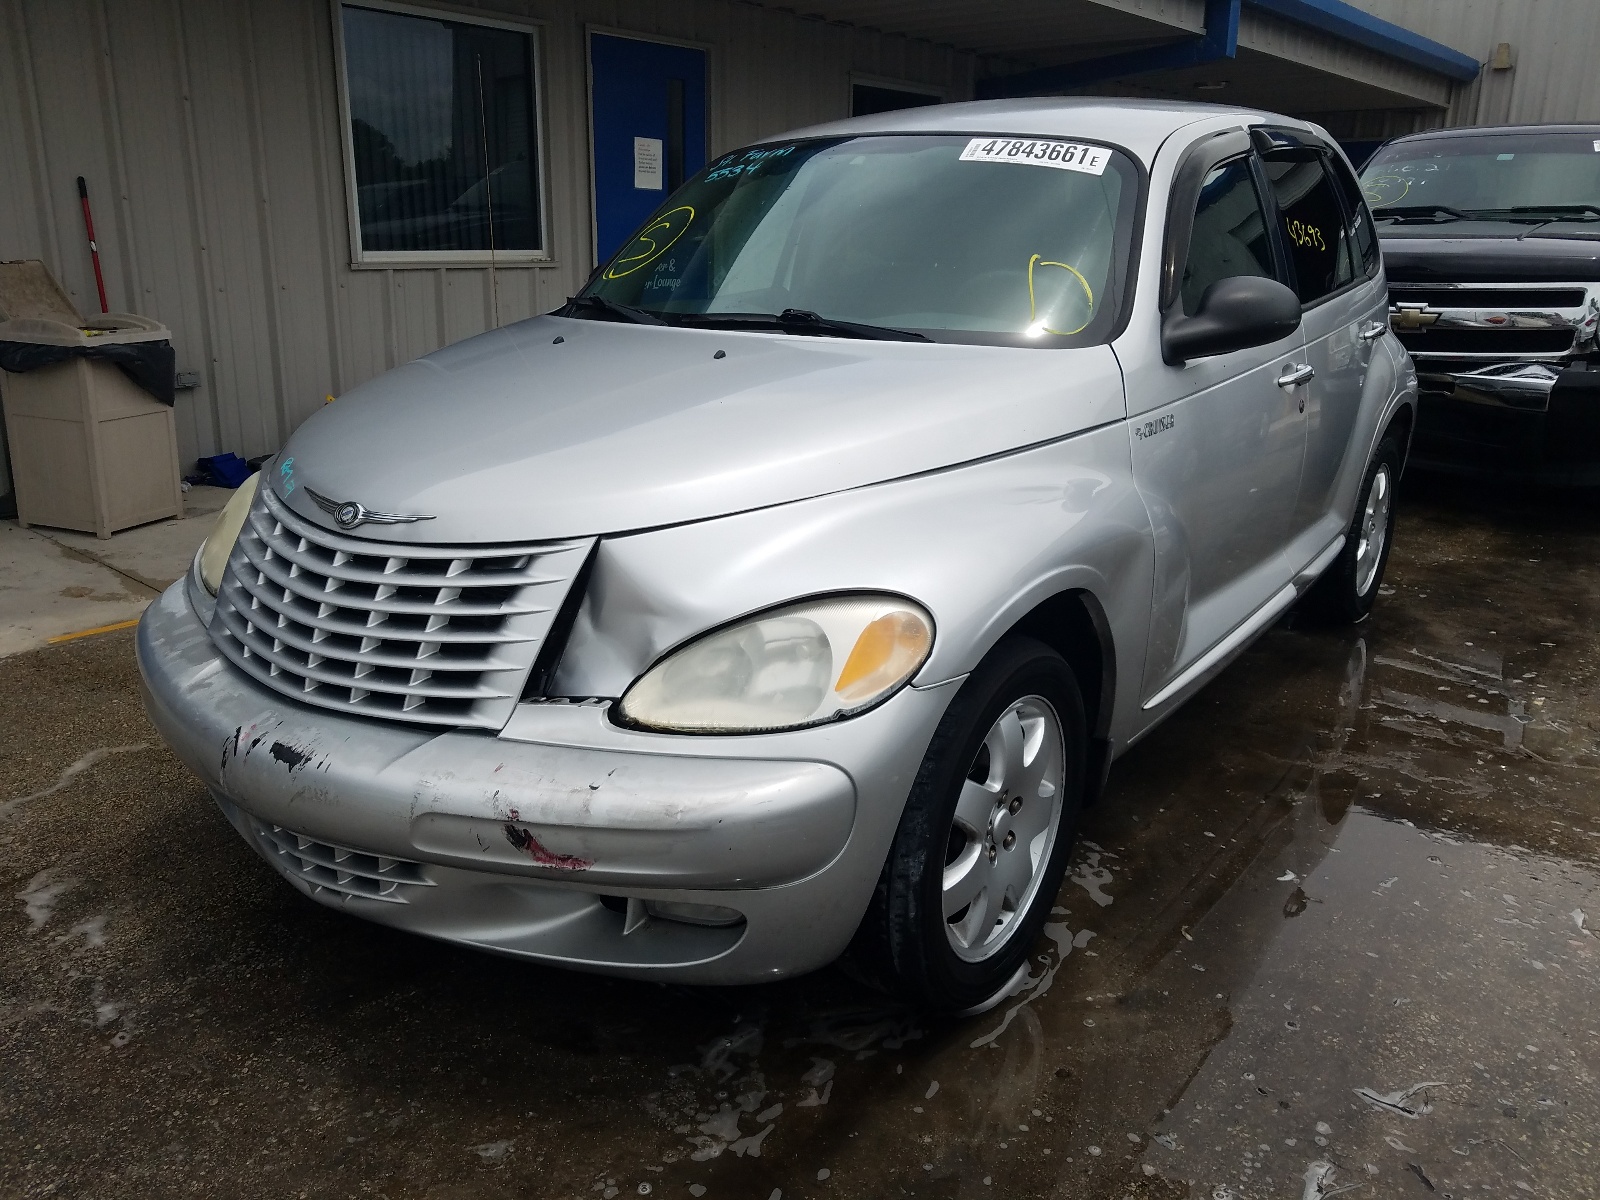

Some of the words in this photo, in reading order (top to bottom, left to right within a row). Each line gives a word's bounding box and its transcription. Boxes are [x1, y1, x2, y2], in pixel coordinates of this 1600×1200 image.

[980, 139, 1090, 165] 47843661
[1089, 155, 1101, 167] E
[703, 160, 764, 183] 5534
[652, 274, 681, 292] Lounge
[1028, 253, 1093, 336] D
